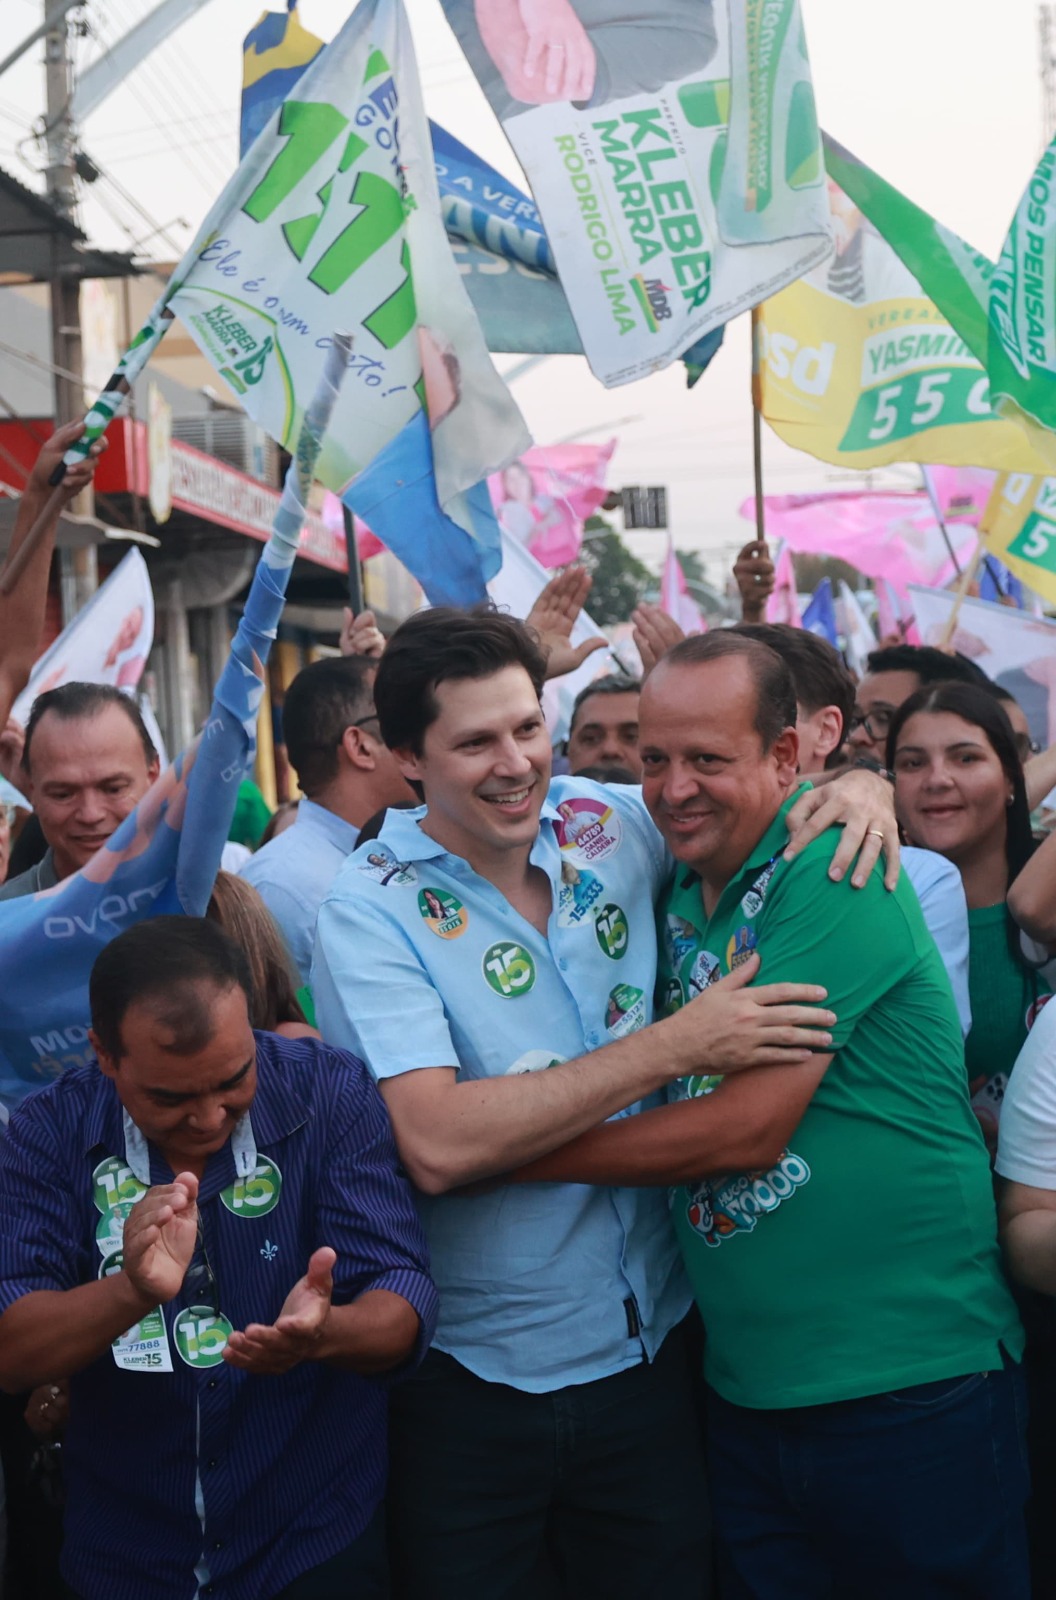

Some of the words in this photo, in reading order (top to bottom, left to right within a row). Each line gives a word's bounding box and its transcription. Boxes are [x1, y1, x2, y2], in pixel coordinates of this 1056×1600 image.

[578, 132, 598, 166] VICE
[591, 118, 664, 266] MARRA
[620, 107, 711, 315] KLEBER
[553, 133, 614, 262] RODRIGO
[599, 267, 637, 337] LIMA
[199, 239, 242, 277] Ele
[644, 278, 673, 322] MDB
[1022, 229, 1047, 363] PENSAR
[211, 303, 259, 354] KLEBER
[584, 833, 608, 853] DANIEL
[585, 836, 617, 860] CALDEIRA
[568, 878, 605, 922] 15.333
[597, 908, 627, 956] 15
[486, 946, 532, 994] 15
[97, 1167, 148, 1210] 15
[232, 1165, 275, 1209] 15
[718, 1176, 749, 1207] HUGO
[726, 1156, 807, 1225] 70000
[128, 1339, 160, 1353] 77888
[144, 1353, 163, 1366] 15
[179, 1316, 228, 1361] 15
